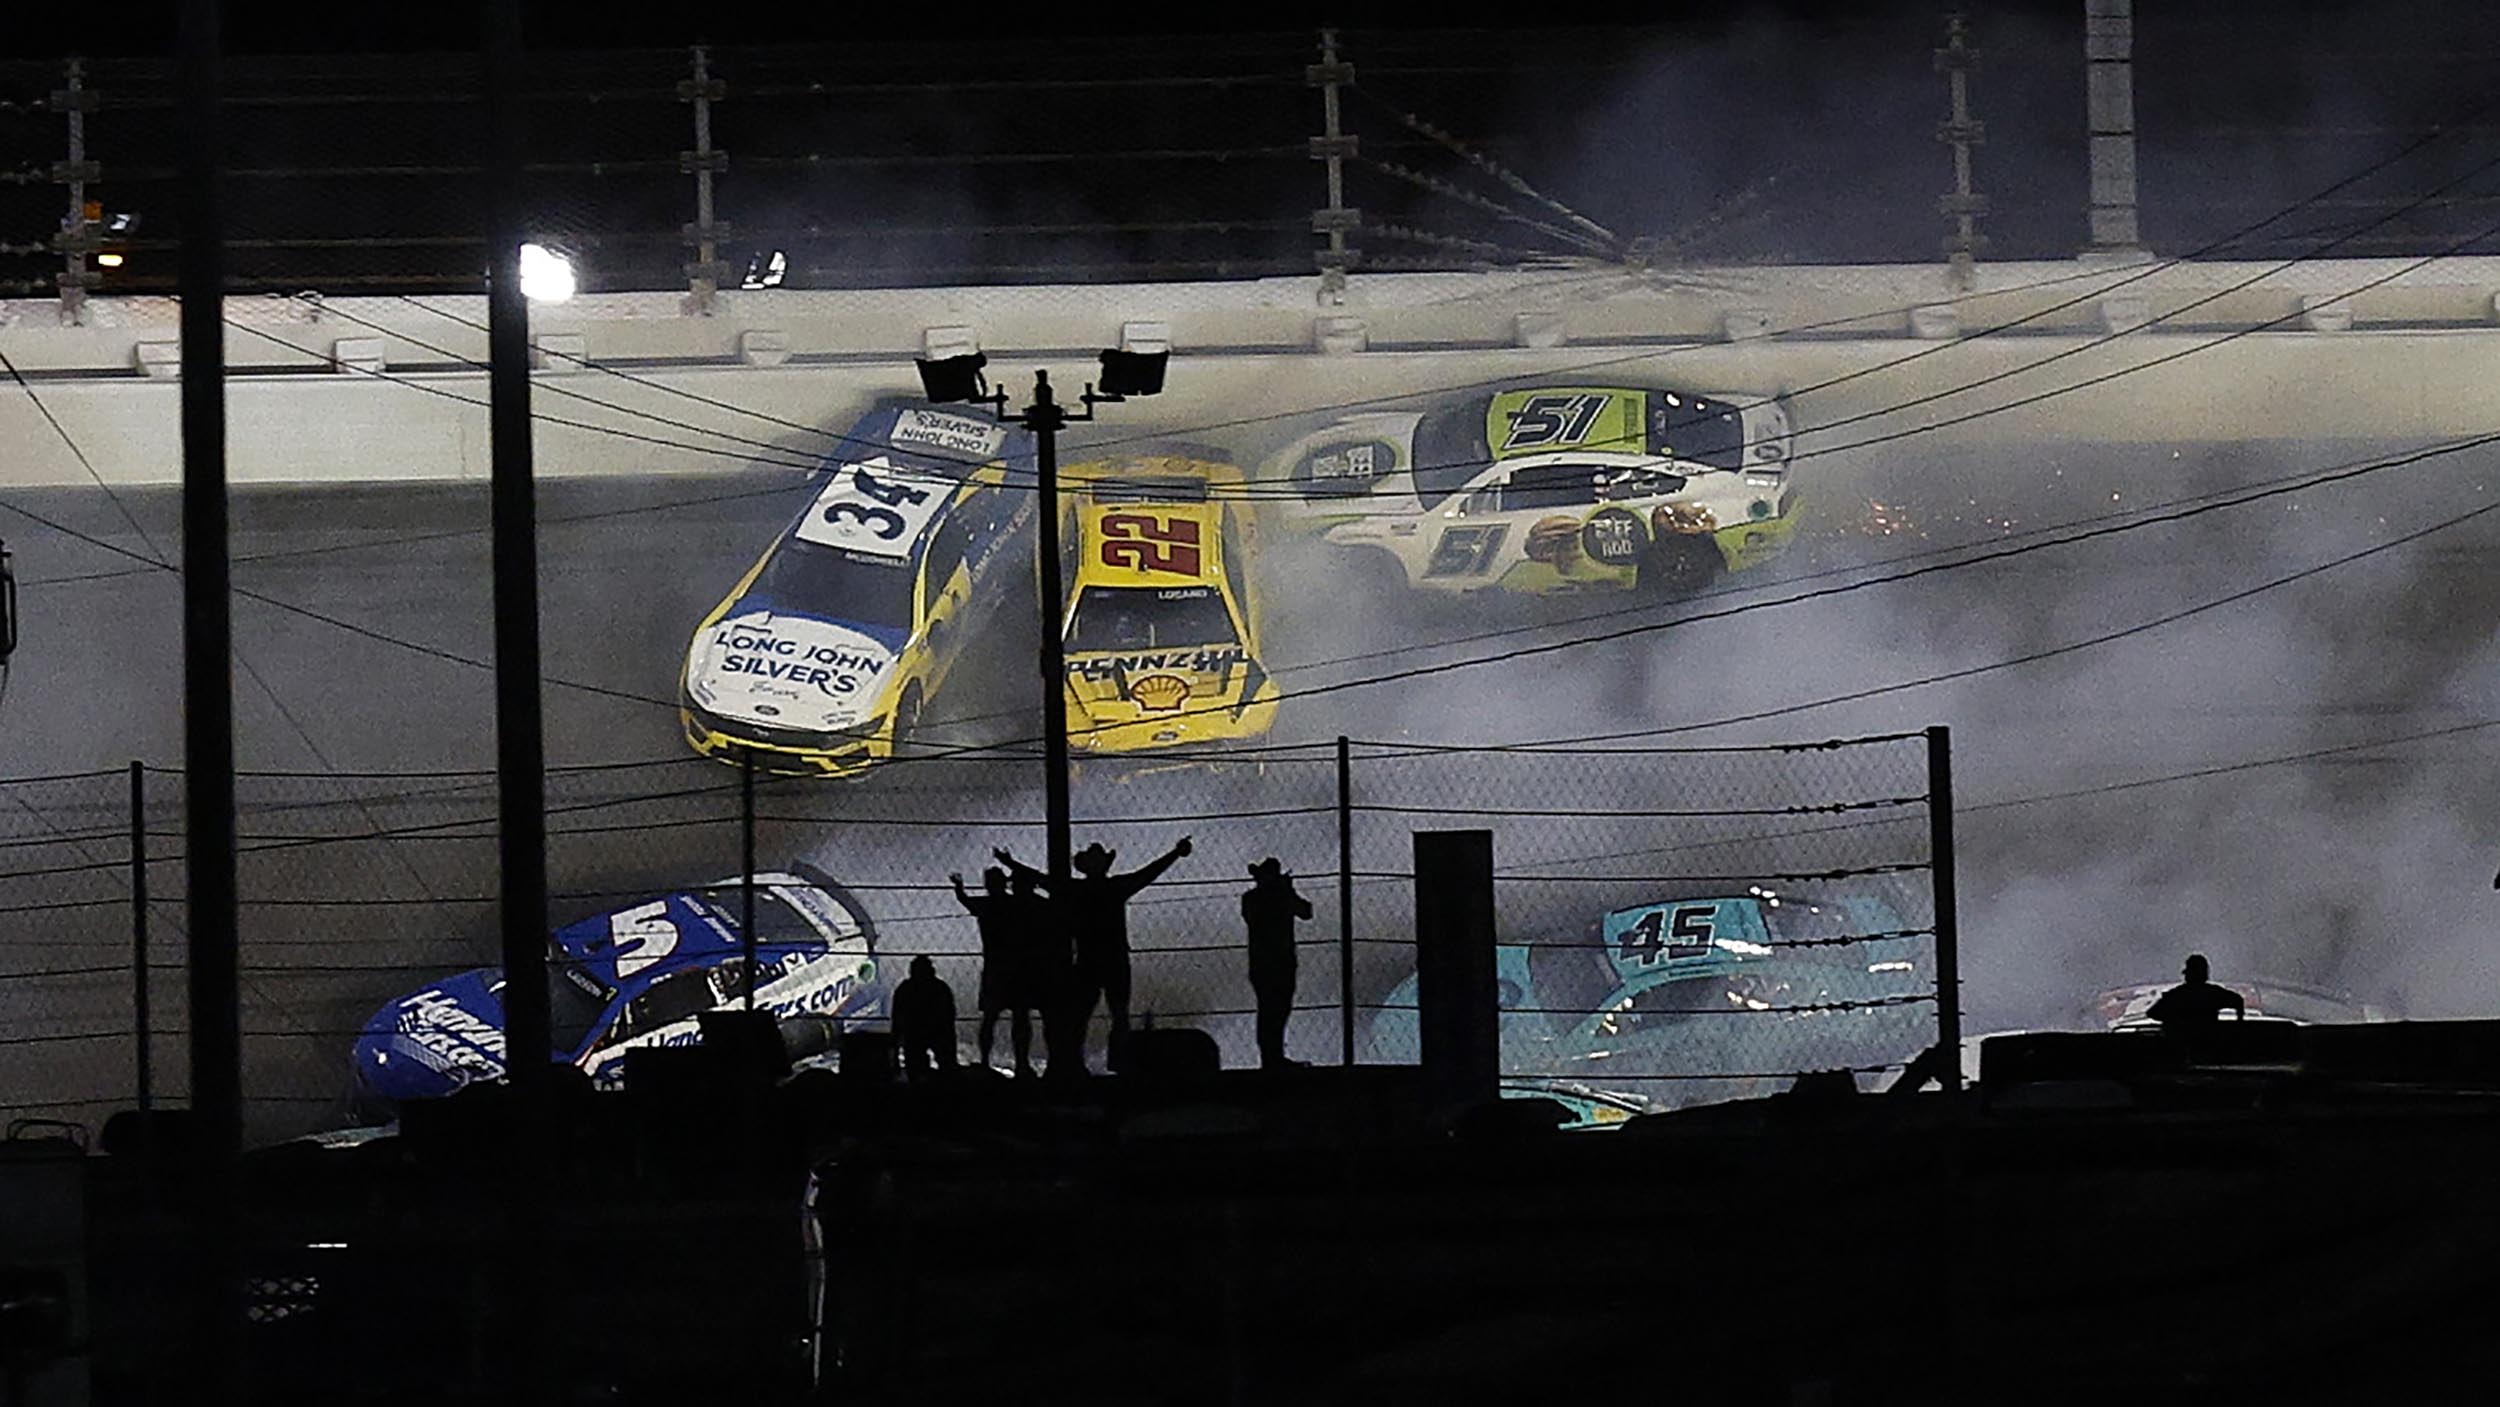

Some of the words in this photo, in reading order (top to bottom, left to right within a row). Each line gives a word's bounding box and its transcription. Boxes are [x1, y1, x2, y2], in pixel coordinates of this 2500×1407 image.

[1507, 395, 1615, 450] 51
[823, 467, 931, 540] 34
[1101, 514, 1200, 577] 22
[716, 631, 797, 655] LONG
[803, 645, 883, 676] JOHN
[721, 654, 857, 698] SILVER'S
[610, 900, 679, 979] 5
[1617, 906, 1719, 967] 45
